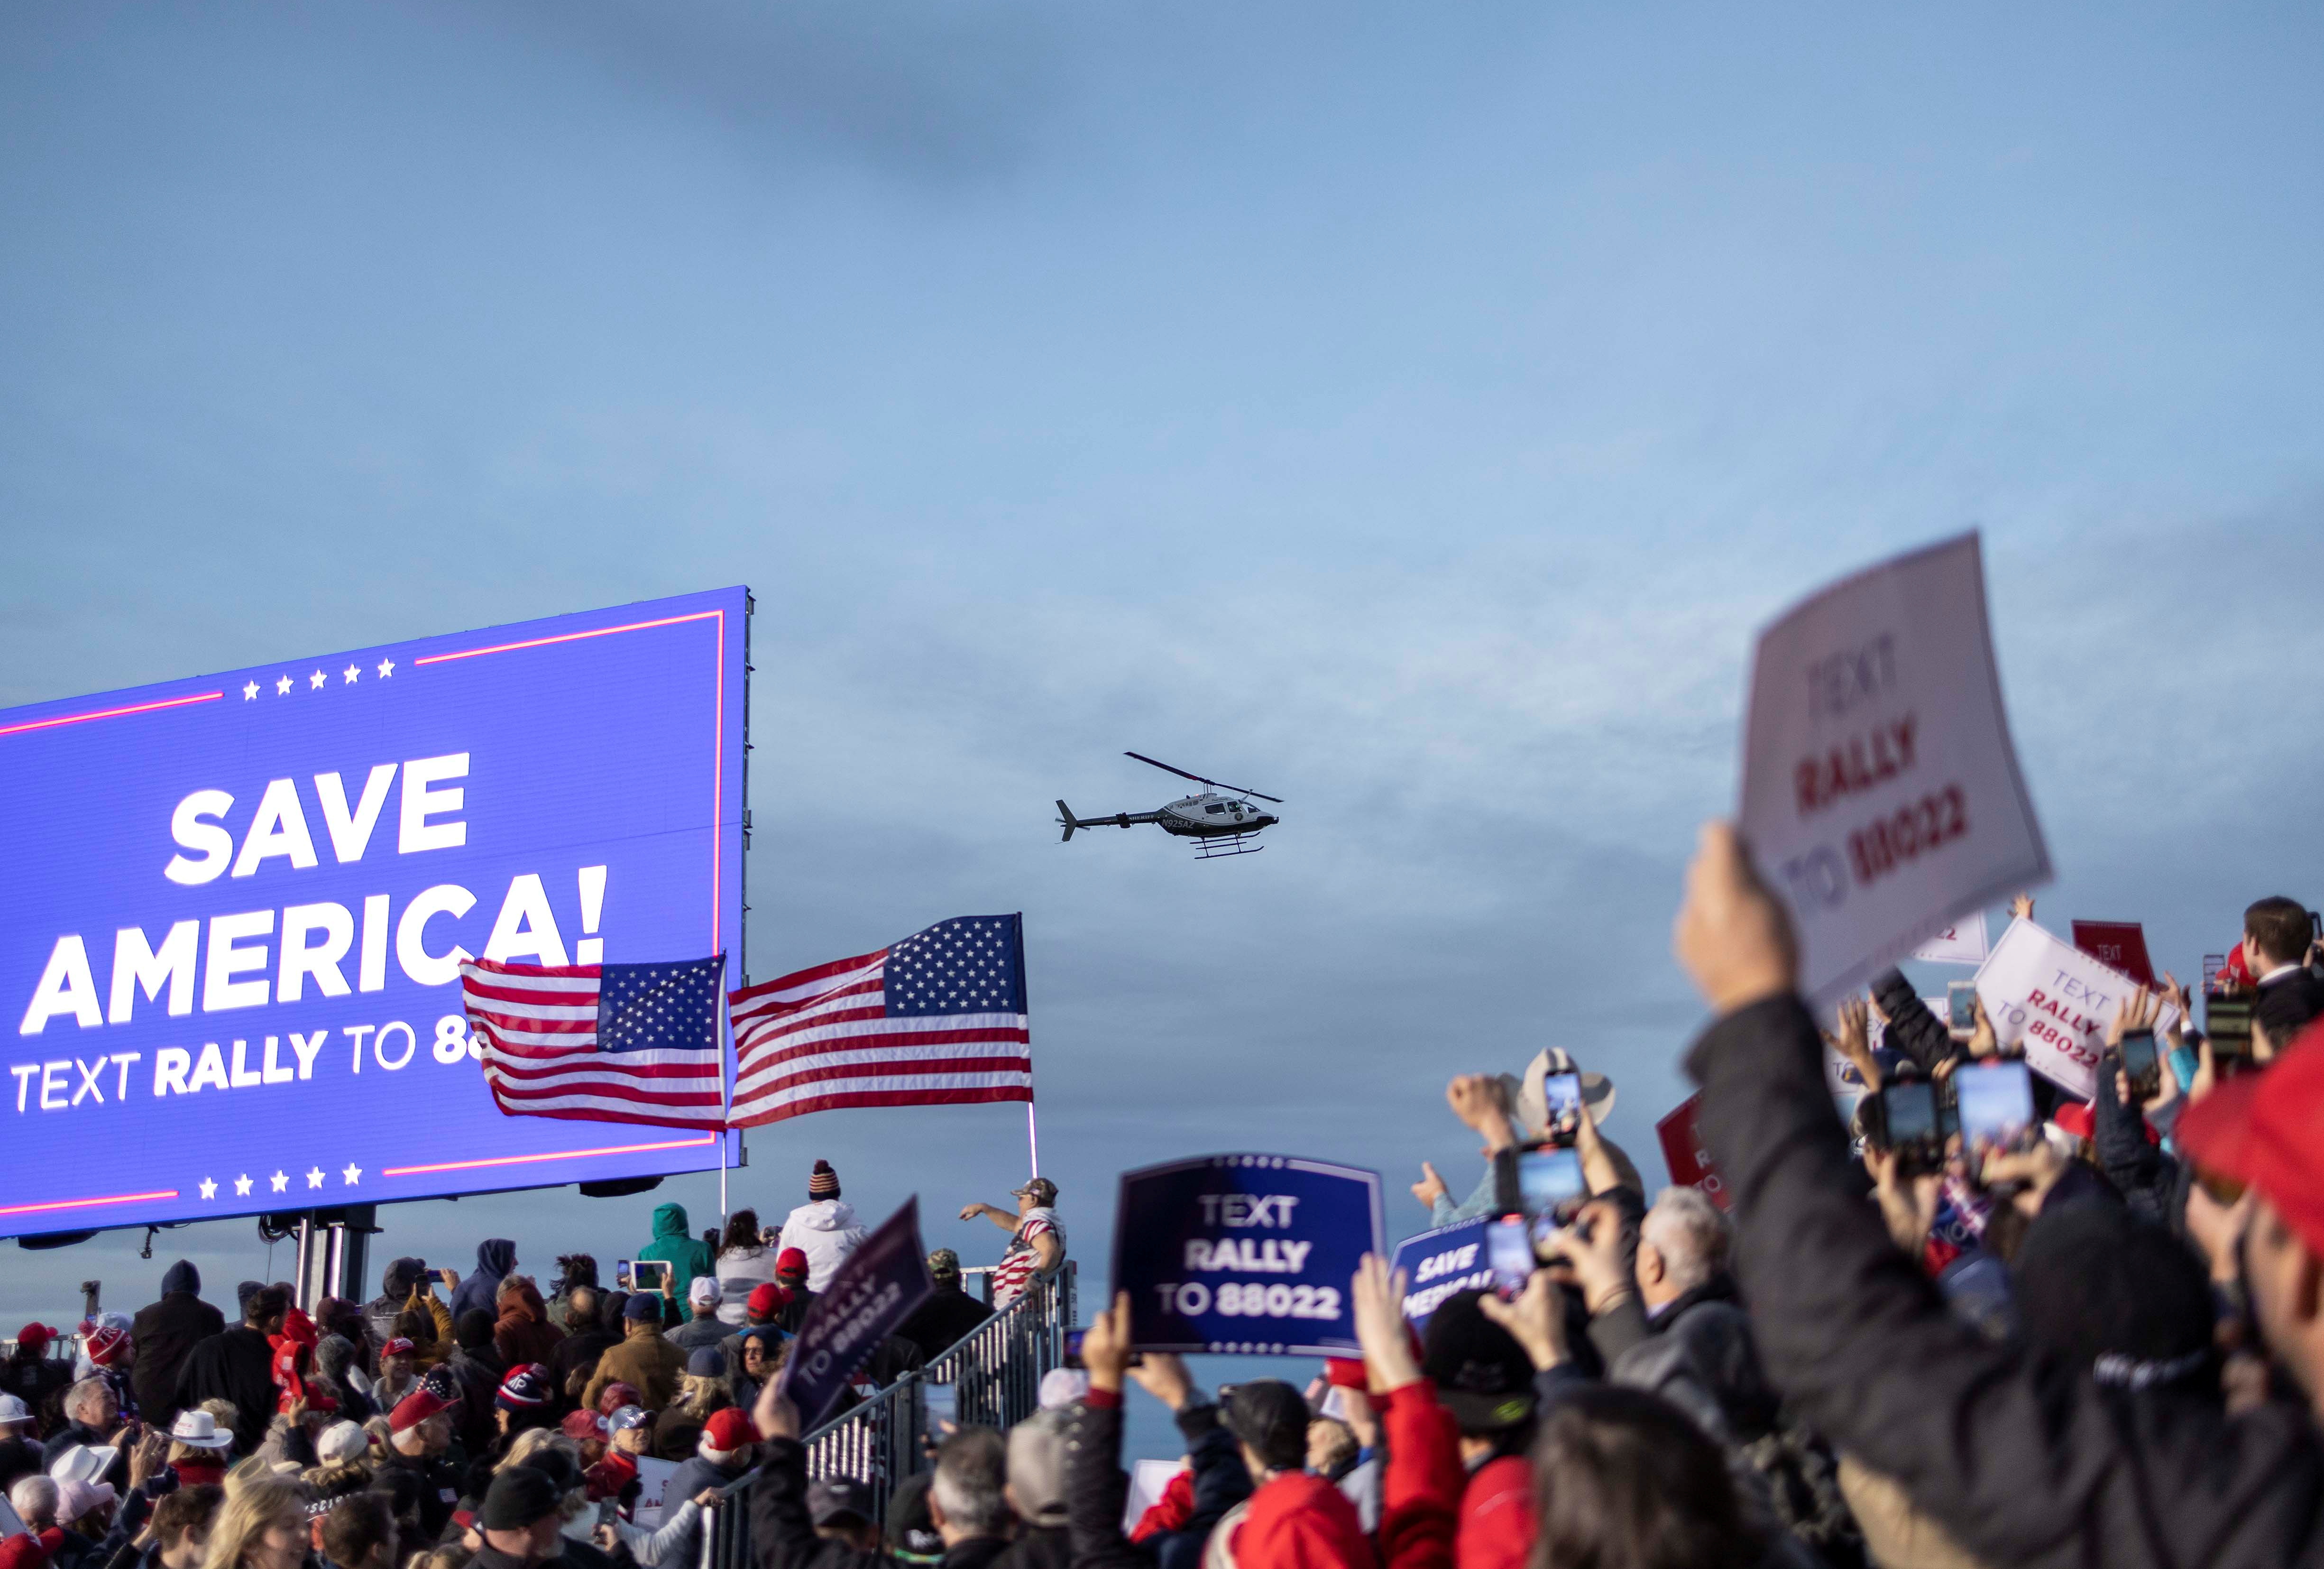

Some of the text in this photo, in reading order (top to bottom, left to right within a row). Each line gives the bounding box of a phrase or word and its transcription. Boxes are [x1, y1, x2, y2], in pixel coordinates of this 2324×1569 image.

[1792, 710, 1917, 819] RALLY
[165, 753, 470, 886] SAVE
[1162, 819, 1195, 829] N925AZ
[1782, 843, 1847, 909] TO
[20, 865, 607, 1034] AMERICA!
[2096, 944, 2122, 961] TEXT
[2053, 969, 2110, 1011] TEXT
[2026, 988, 2102, 1036] RALLY
[1997, 999, 2099, 1070] TO 88022
[11, 1053, 141, 1112] TEXT
[155, 1031, 329, 1096] RALLY
[344, 1021, 416, 1073] TO
[1197, 1193, 1300, 1228] TEXT
[1184, 1237, 1313, 1274] RALLY
[1415, 1243, 1480, 1283] SAVE
[1153, 1282, 1342, 1321] TO 88022
[798, 1349, 832, 1387] TO
